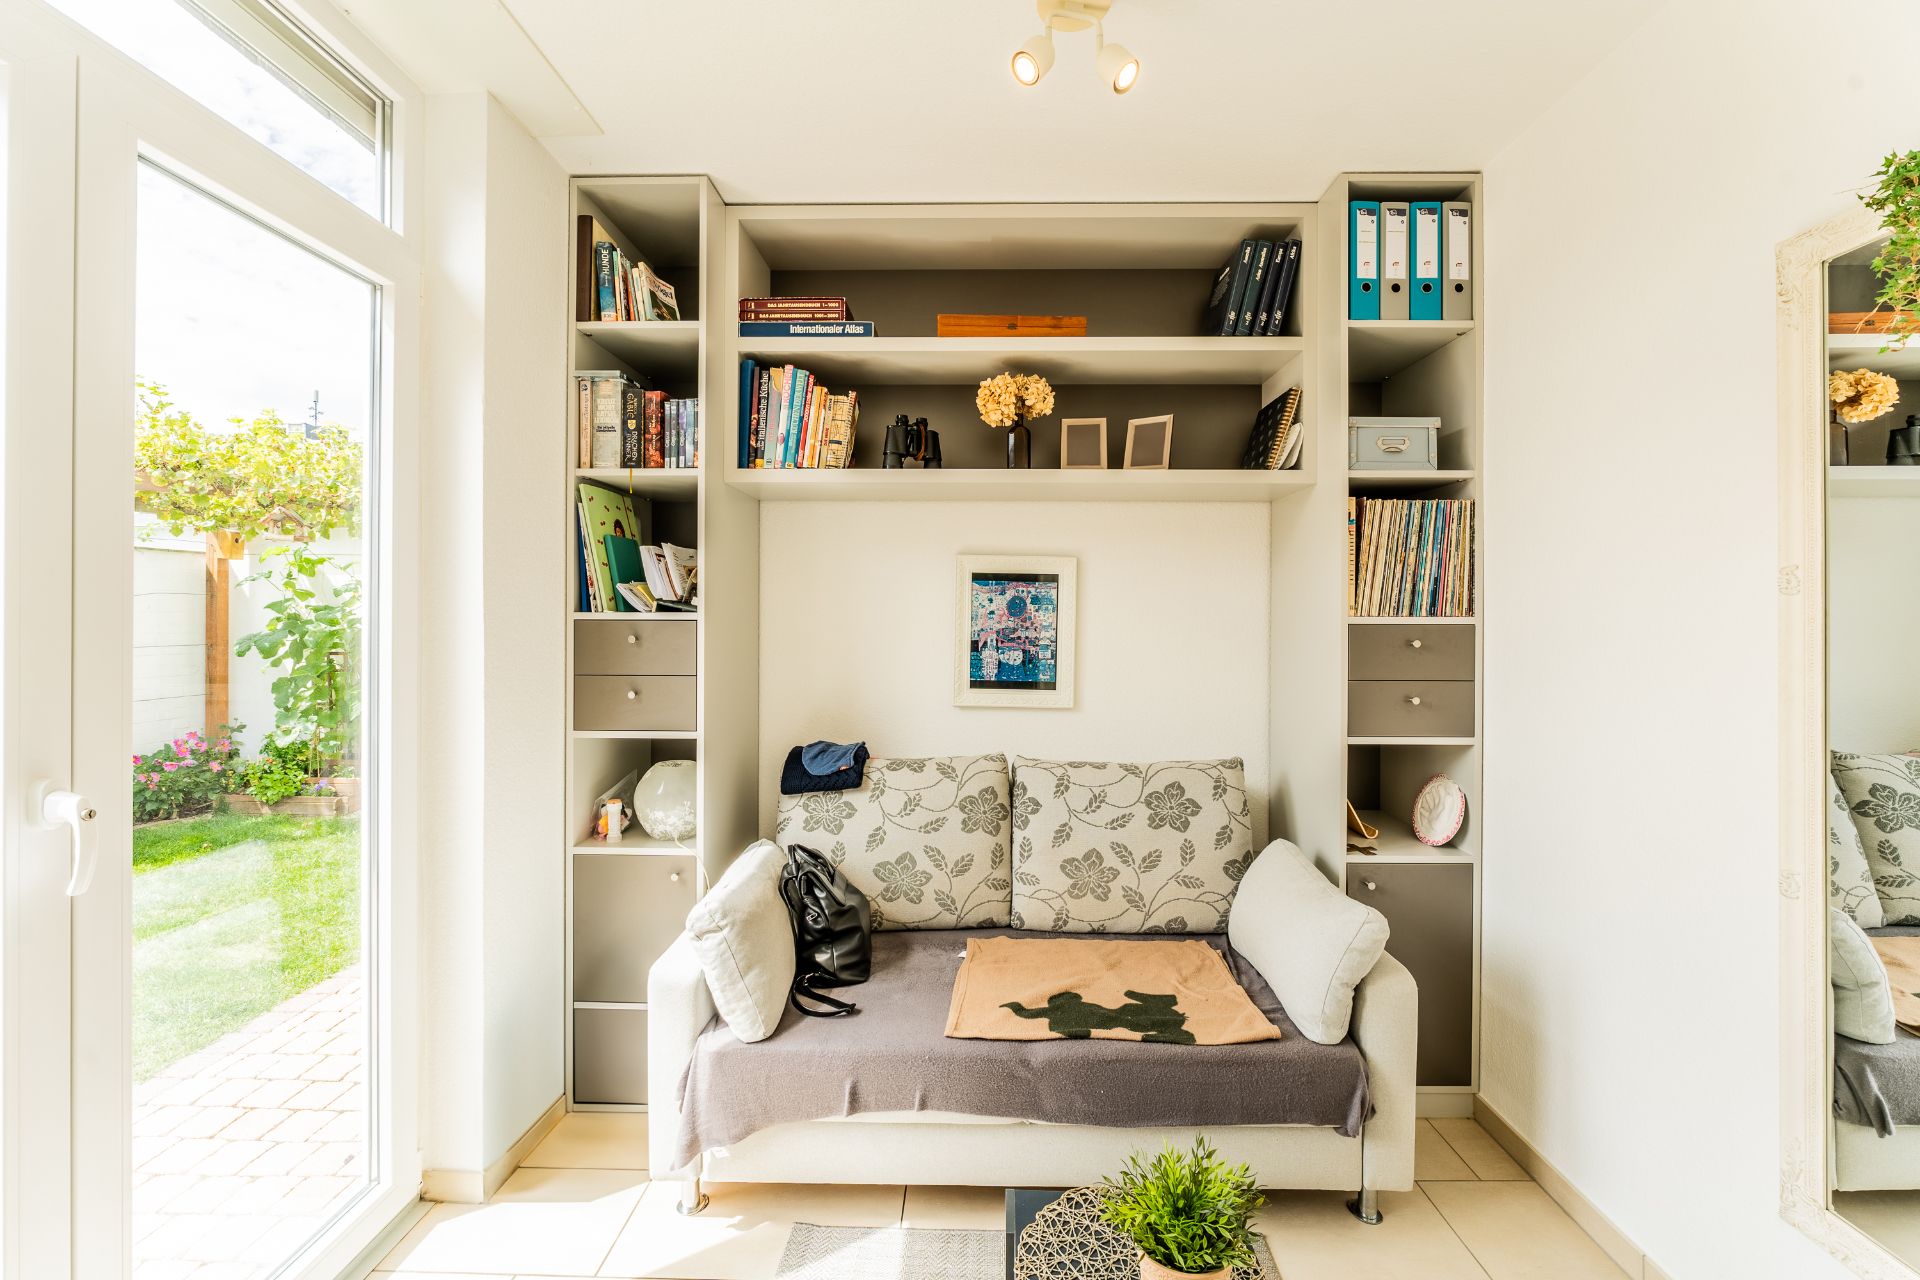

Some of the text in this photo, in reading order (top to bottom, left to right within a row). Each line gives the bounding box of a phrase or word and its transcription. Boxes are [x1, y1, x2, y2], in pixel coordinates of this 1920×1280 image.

[601, 249, 609, 274] HUNDE
[789, 324, 864, 334] Internationaler Atlas
[757, 373, 769, 440] italienische Küche
